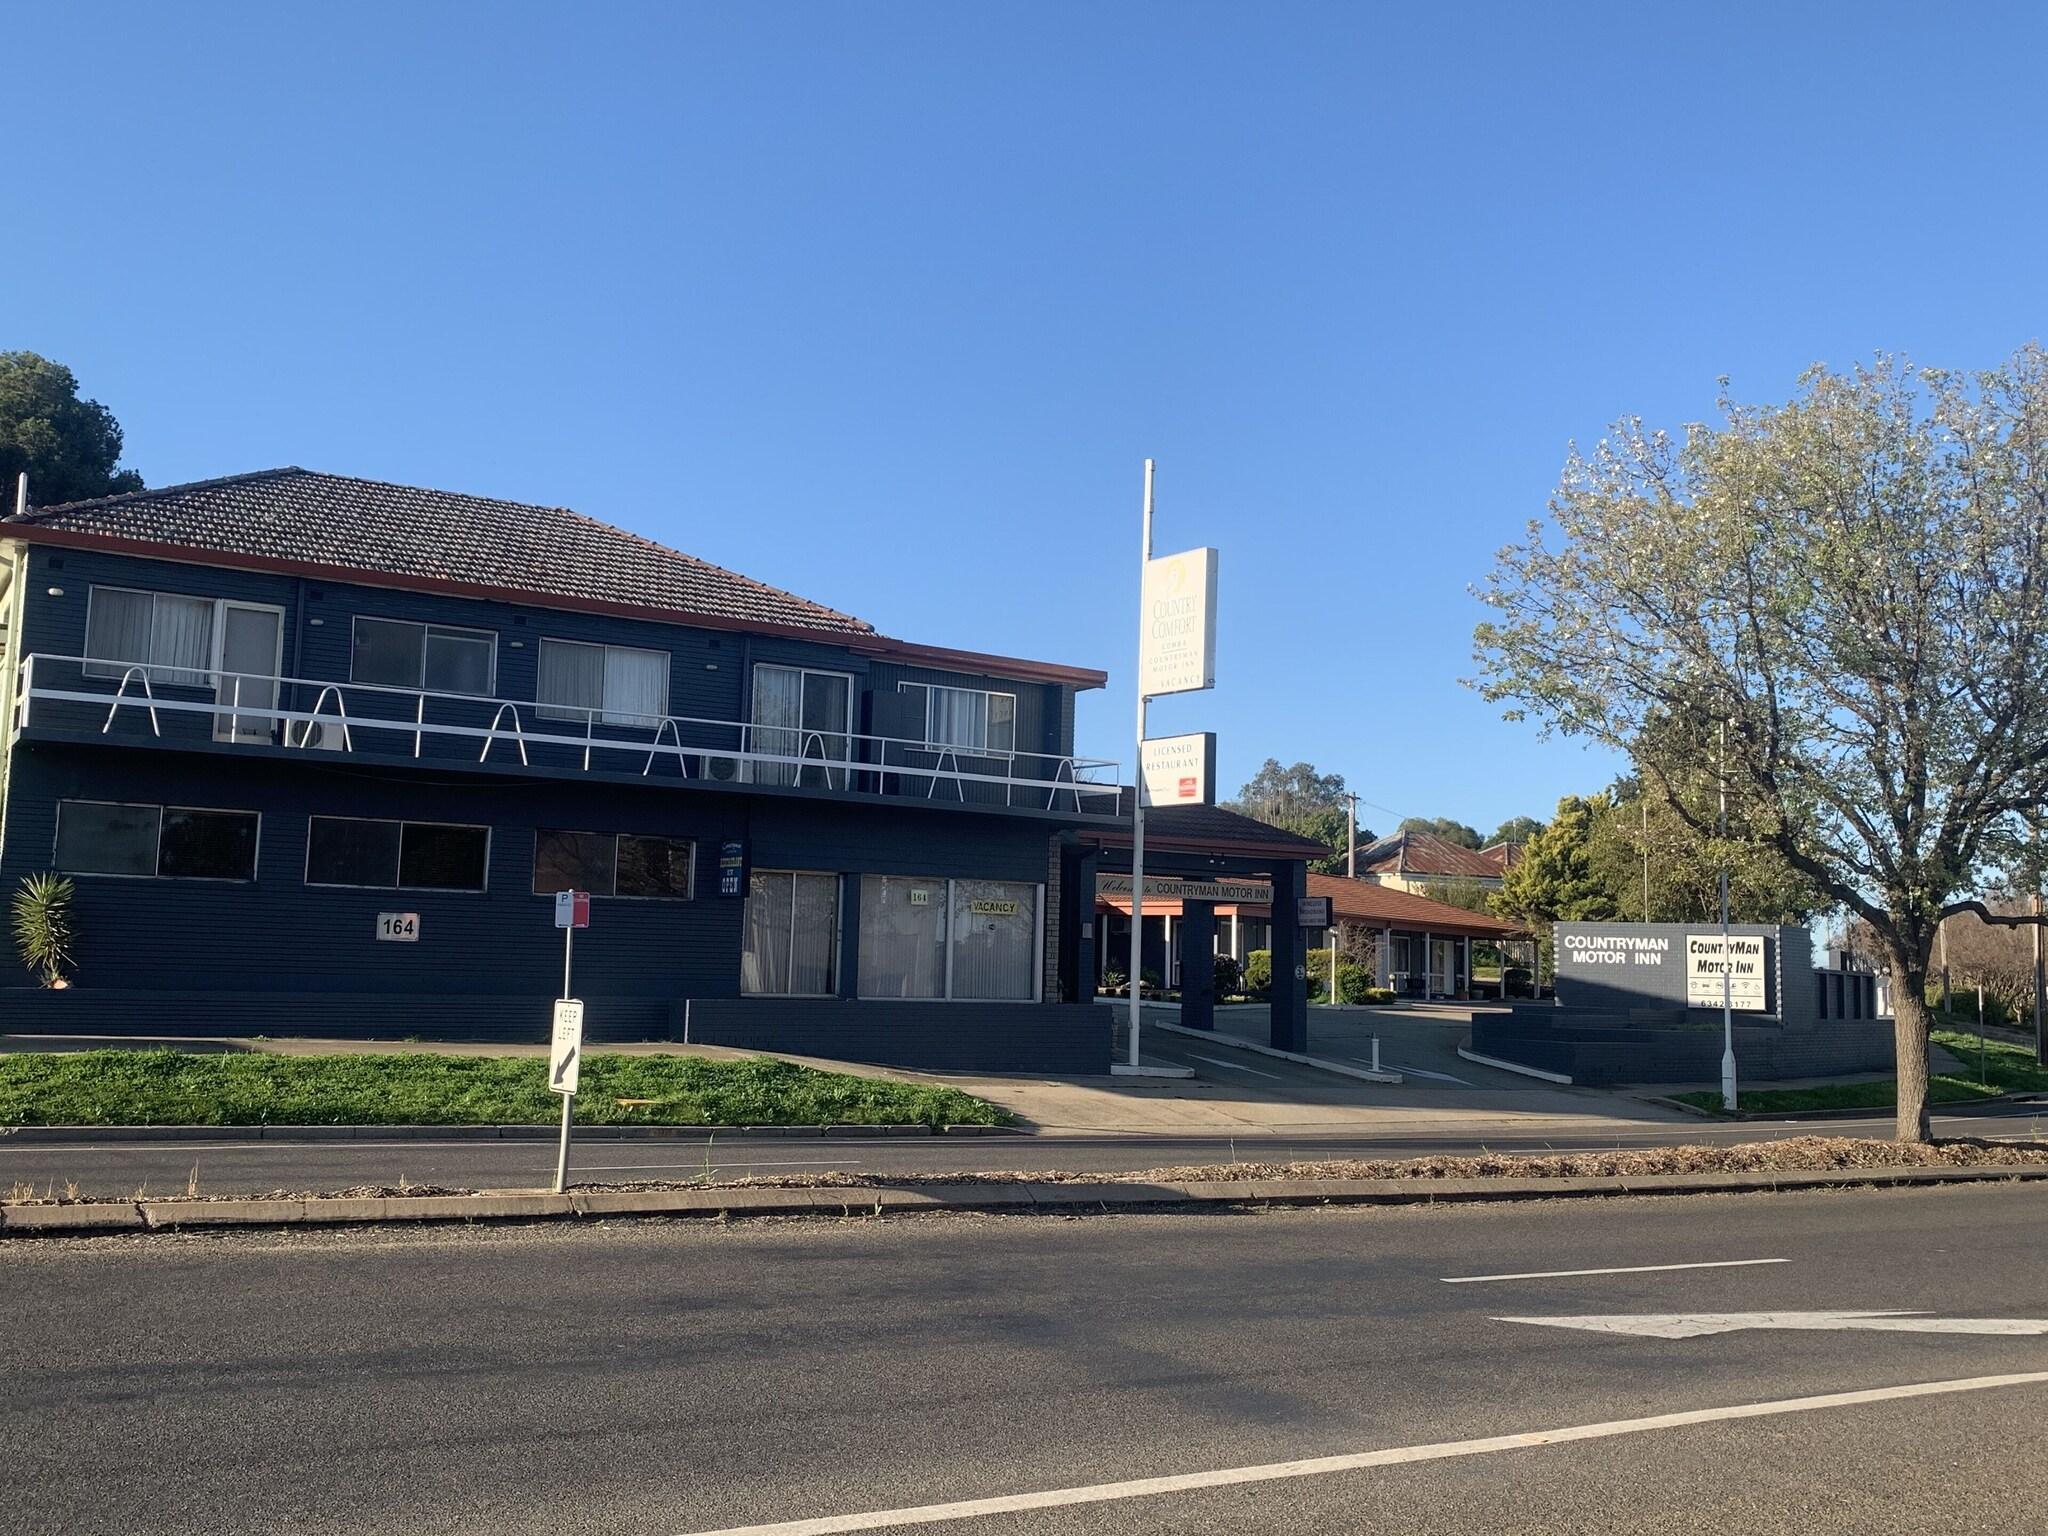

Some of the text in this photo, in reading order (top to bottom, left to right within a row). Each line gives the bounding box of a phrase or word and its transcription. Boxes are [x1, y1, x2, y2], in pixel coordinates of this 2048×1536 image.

[1153, 594, 1200, 619] COUNTRY
[1152, 616, 1198, 639] COMFORT
[1153, 744, 1192, 756] LICENSED
[1146, 758, 1199, 770] RESTAURANT
[1102, 880, 1134, 892] Welcom
[1157, 882, 1219, 897] COUNTRYMAN
[1221, 886, 1252, 898] MOTOR
[1254, 889, 1269, 899] INN
[561, 894, 569, 902] P
[973, 901, 1015, 912] VACANCY
[383, 919, 414, 935] 164
[1564, 935, 1669, 950] COUNTRYMAN
[1690, 940, 1760, 955] COUNTYMAN
[1572, 951, 1662, 965] MOTOR INN
[1735, 960, 1754, 973] INN
[560, 1009, 577, 1023] KEEP
[558, 1026, 575, 1040] LEFT
